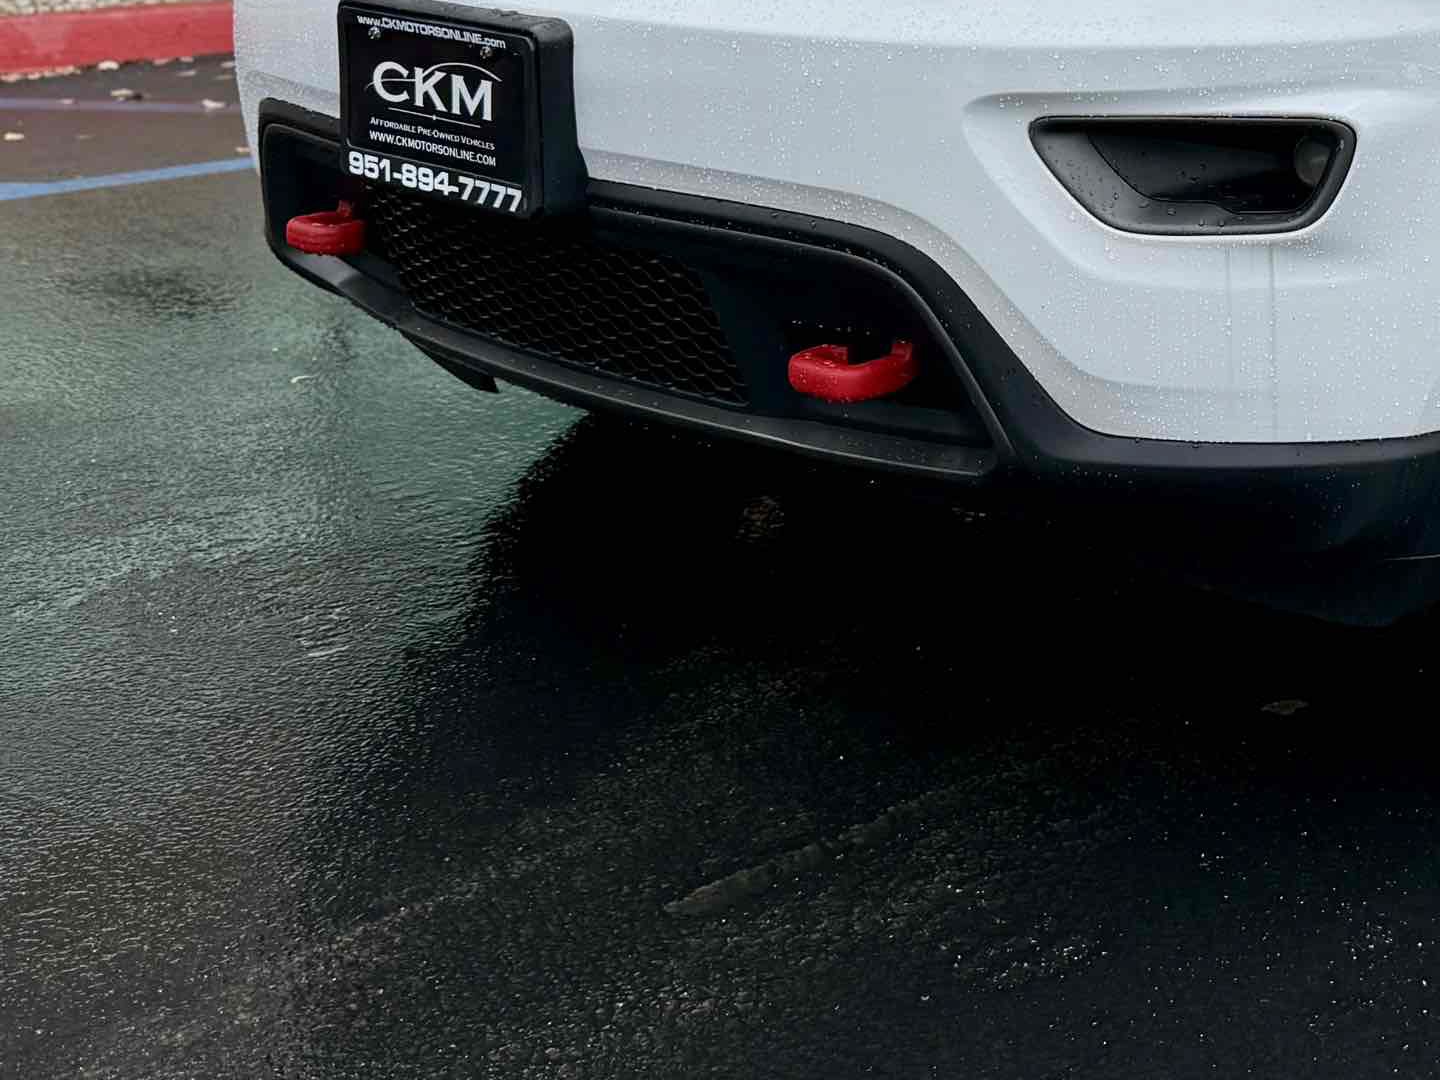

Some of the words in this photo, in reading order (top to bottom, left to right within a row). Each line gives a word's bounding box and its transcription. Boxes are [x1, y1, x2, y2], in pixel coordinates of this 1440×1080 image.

[357, 15, 506, 49] www.CKMOTORSONLINE.com
[371, 61, 493, 121] CKM
[369, 130, 496, 167] WWW.CKMOTORSONLINE.COM
[349, 151, 522, 212] 951-894-7777
